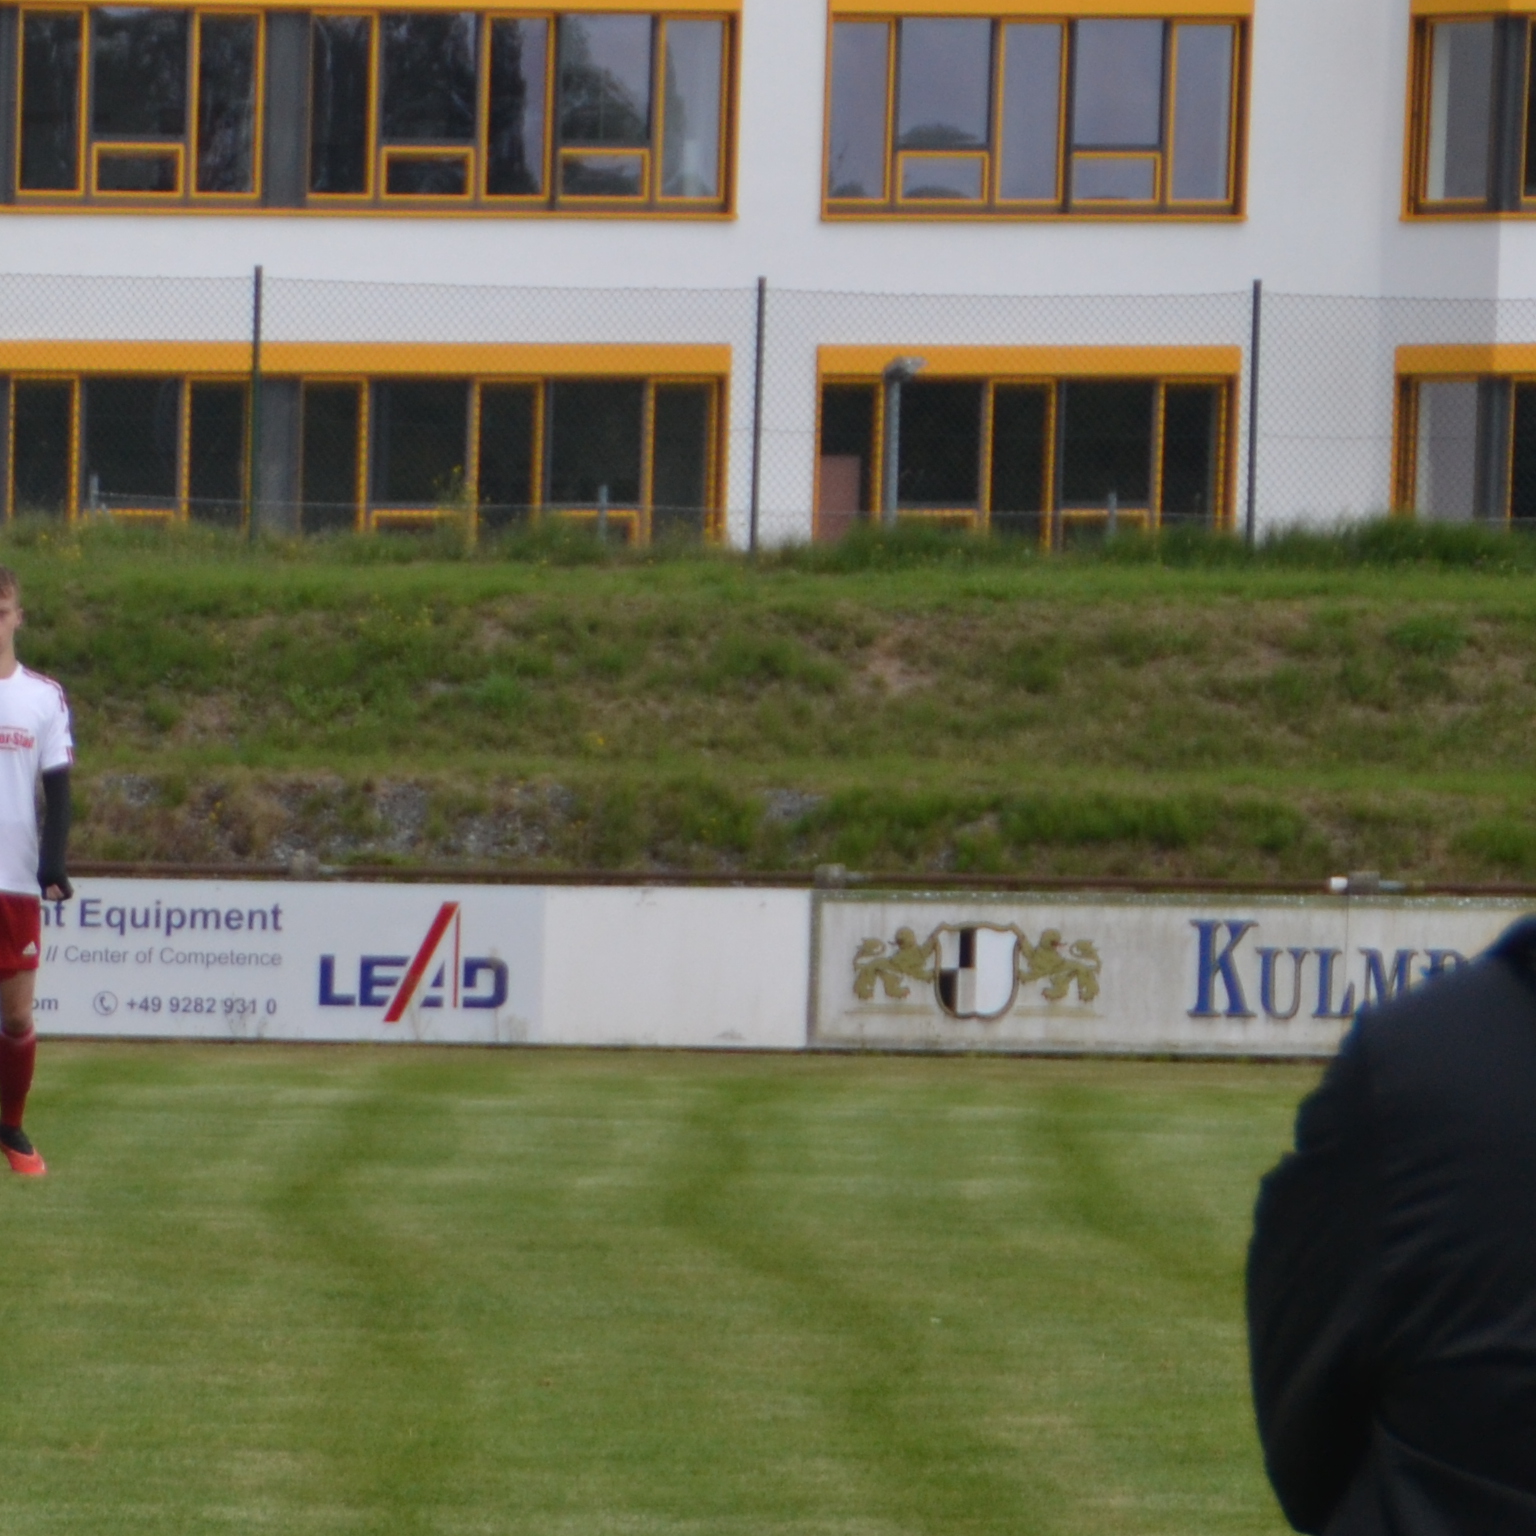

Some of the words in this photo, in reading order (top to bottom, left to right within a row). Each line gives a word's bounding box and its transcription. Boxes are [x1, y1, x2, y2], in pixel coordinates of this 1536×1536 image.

[79, 898, 284, 937] Equipment
[64, 945, 129, 965] Center
[135, 946, 154, 964] of
[159, 946, 283, 969] Competence
[317, 901, 509, 1023] LEAD
[127, 996, 163, 1014] +49
[169, 996, 217, 1015] 9282
[224, 997, 257, 1016] 931
[266, 998, 278, 1016] 0
